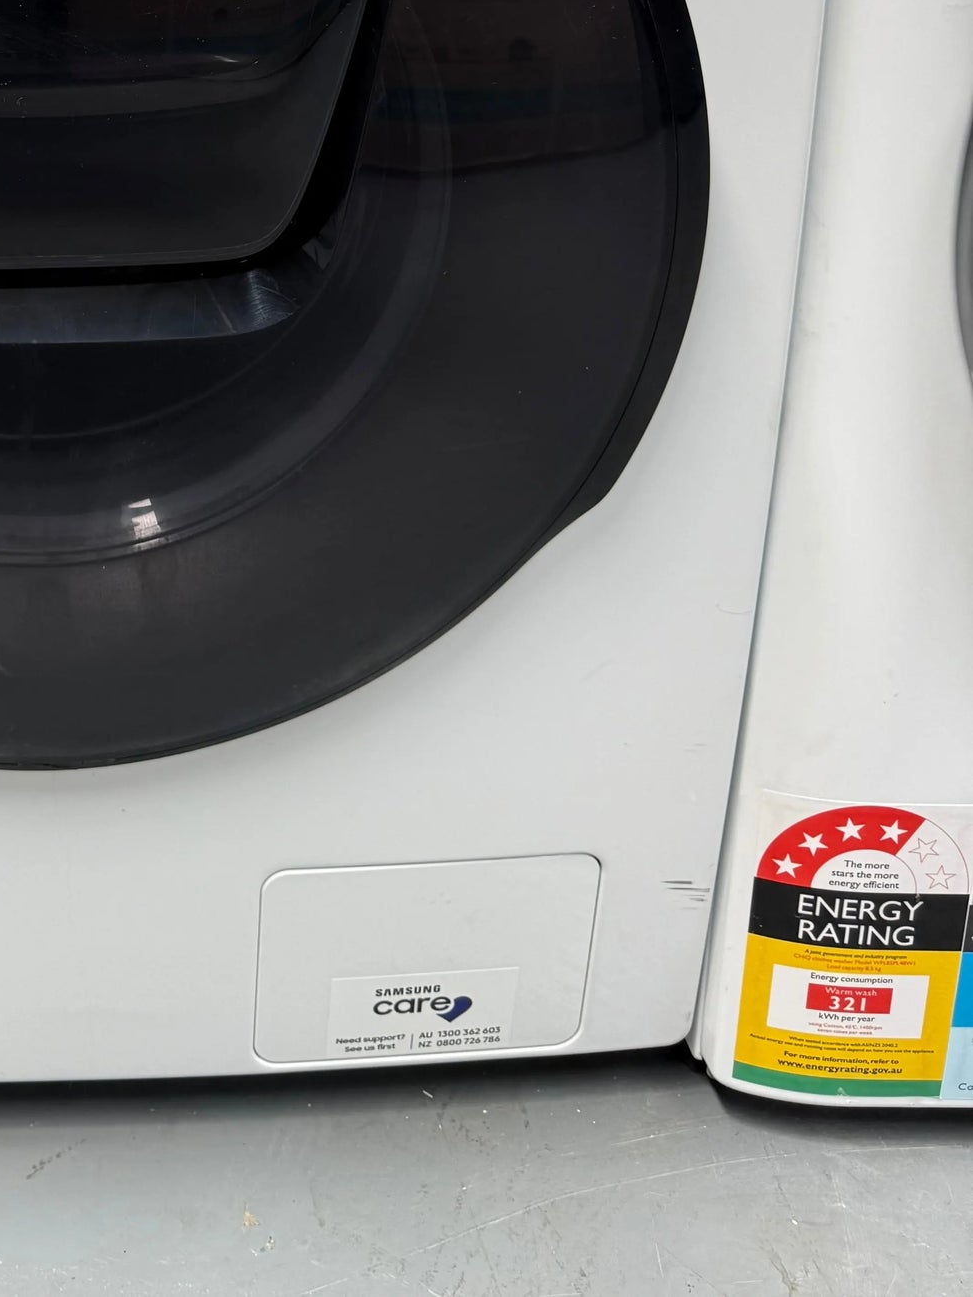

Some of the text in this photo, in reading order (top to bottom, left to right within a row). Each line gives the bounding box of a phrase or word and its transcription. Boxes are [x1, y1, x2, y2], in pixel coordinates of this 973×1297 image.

[844, 859, 890, 870] The more
[831, 870, 855, 878] stars
[856, 870, 872, 879] the
[829, 879, 900, 890] energy efficient
[797, 893, 924, 922] ENERGY
[797, 919, 916, 947] RATING
[810, 972, 893, 985] Energy consumption
[375, 984, 441, 997] SAMSUNG
[825, 986, 878, 997] Warm wash
[373, 996, 452, 1015] care
[828, 996, 867, 1012] 321
[818, 1012, 876, 1024] kWh per year
[438, 1029, 461, 1038] 1300
[462, 1028, 481, 1037] 362
[482, 1026, 501, 1035] 603
[335, 1033, 406, 1045] Need support?
[436, 1038, 462, 1047] 0800
[463, 1037, 481, 1045] 726
[483, 1035, 501, 1044] 786
[344, 1045, 362, 1053] See
[377, 1043, 396, 1051] first
[783, 1050, 798, 1058] For
[799, 1053, 821, 1061] more
[821, 1056, 870, 1065] information,
[777, 1059, 903, 1075] www.energyrating.gov.au
